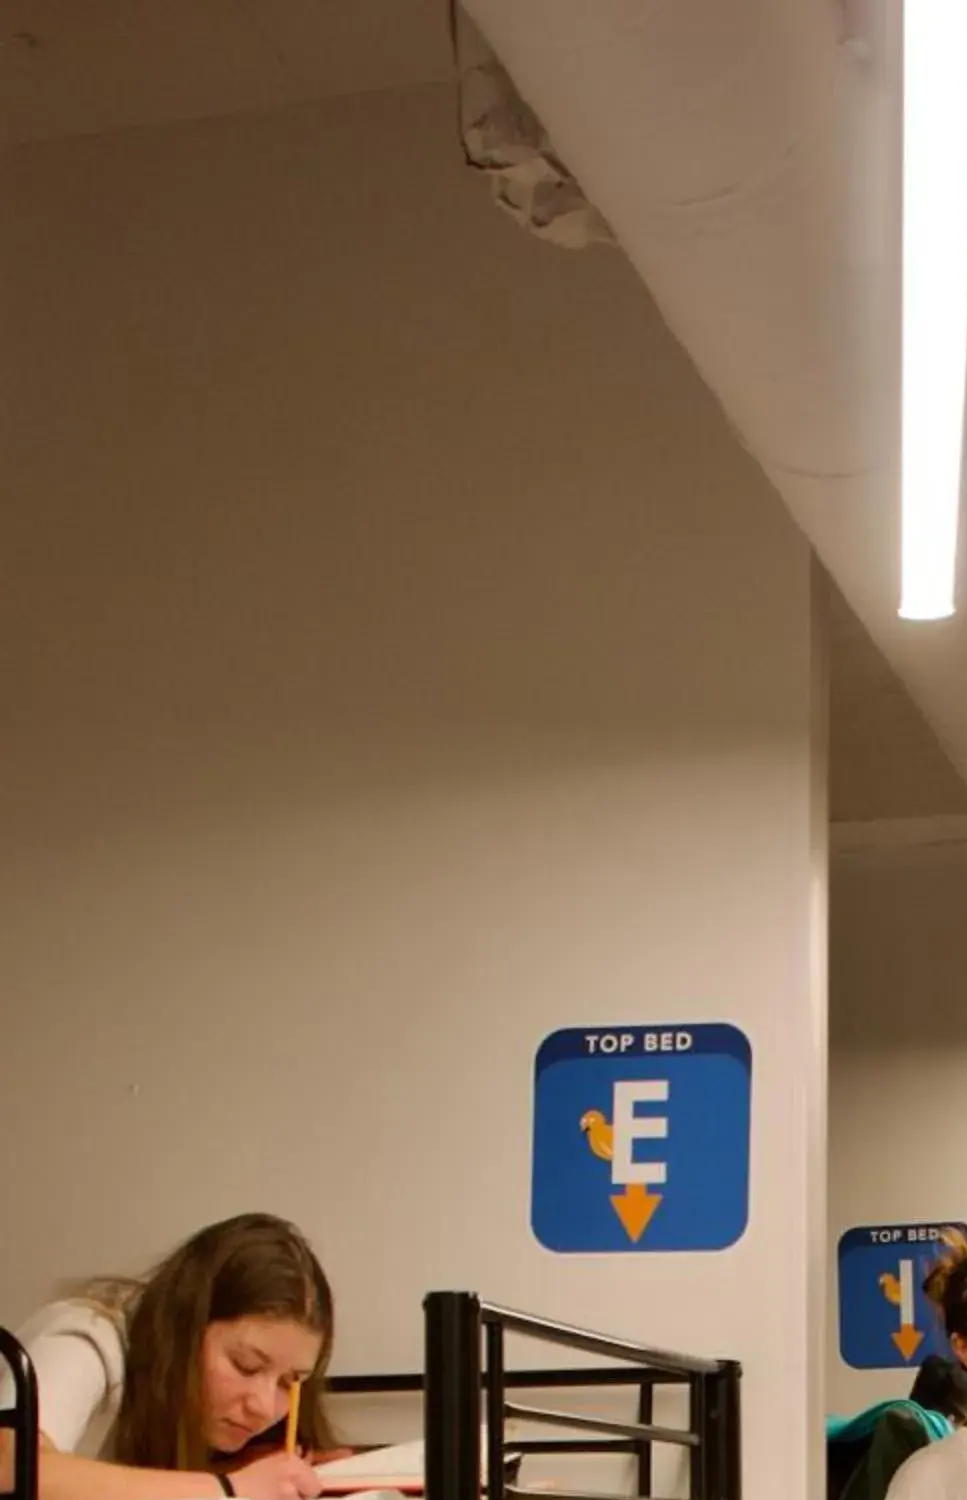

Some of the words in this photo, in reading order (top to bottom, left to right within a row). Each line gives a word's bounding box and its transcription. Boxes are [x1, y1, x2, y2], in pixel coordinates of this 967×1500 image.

[585, 1034, 634, 1053] TOP
[644, 1032, 693, 1051] BED
[611, 1079, 669, 1184] E
[870, 1229, 902, 1243] TOP
[907, 1227, 940, 1241] BED
[899, 1259, 914, 1325] I
